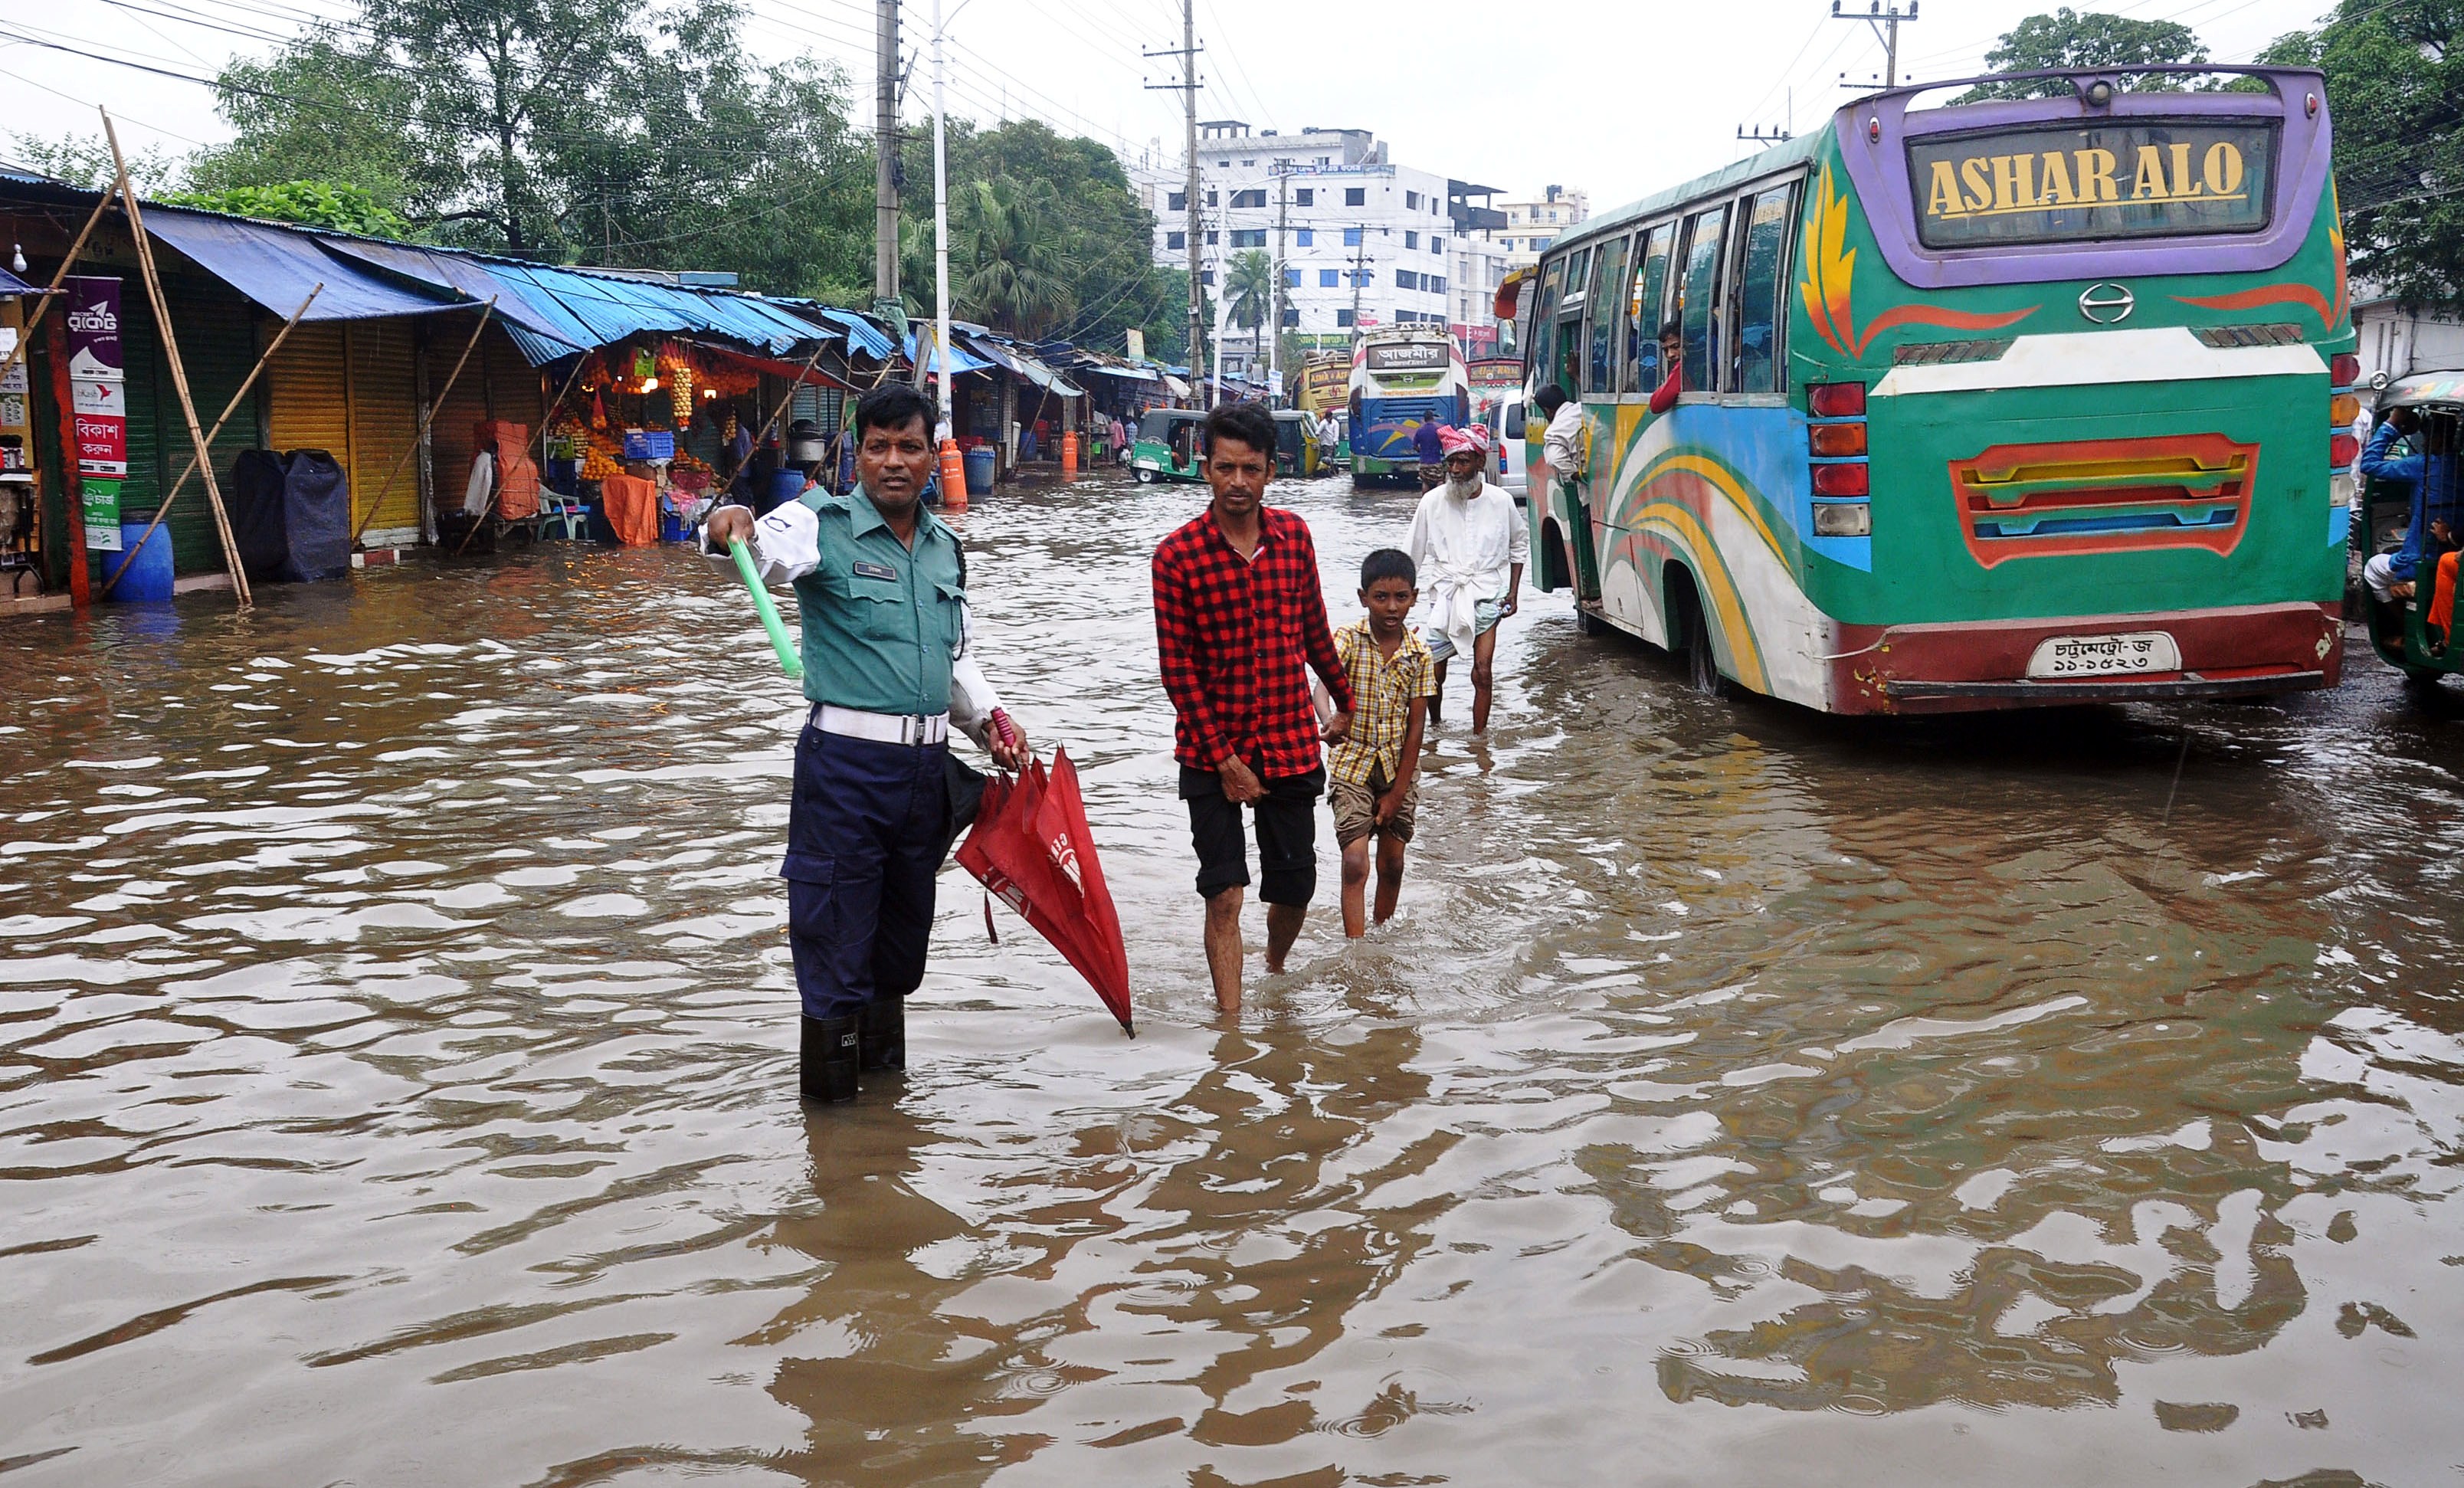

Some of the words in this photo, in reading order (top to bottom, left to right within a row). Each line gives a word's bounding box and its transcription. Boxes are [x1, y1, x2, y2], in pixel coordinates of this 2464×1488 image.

[1928, 148, 2118, 215] ASHAR
[2131, 142, 2243, 198] ALO
[1378, 345, 1438, 361] আজমীর
[75, 418, 119, 440] বিকাশ
[81, 443, 113, 457] করুন
[2131, 640, 2154, 651] জ
[2054, 658, 2148, 670] ১১-১৫২৩
